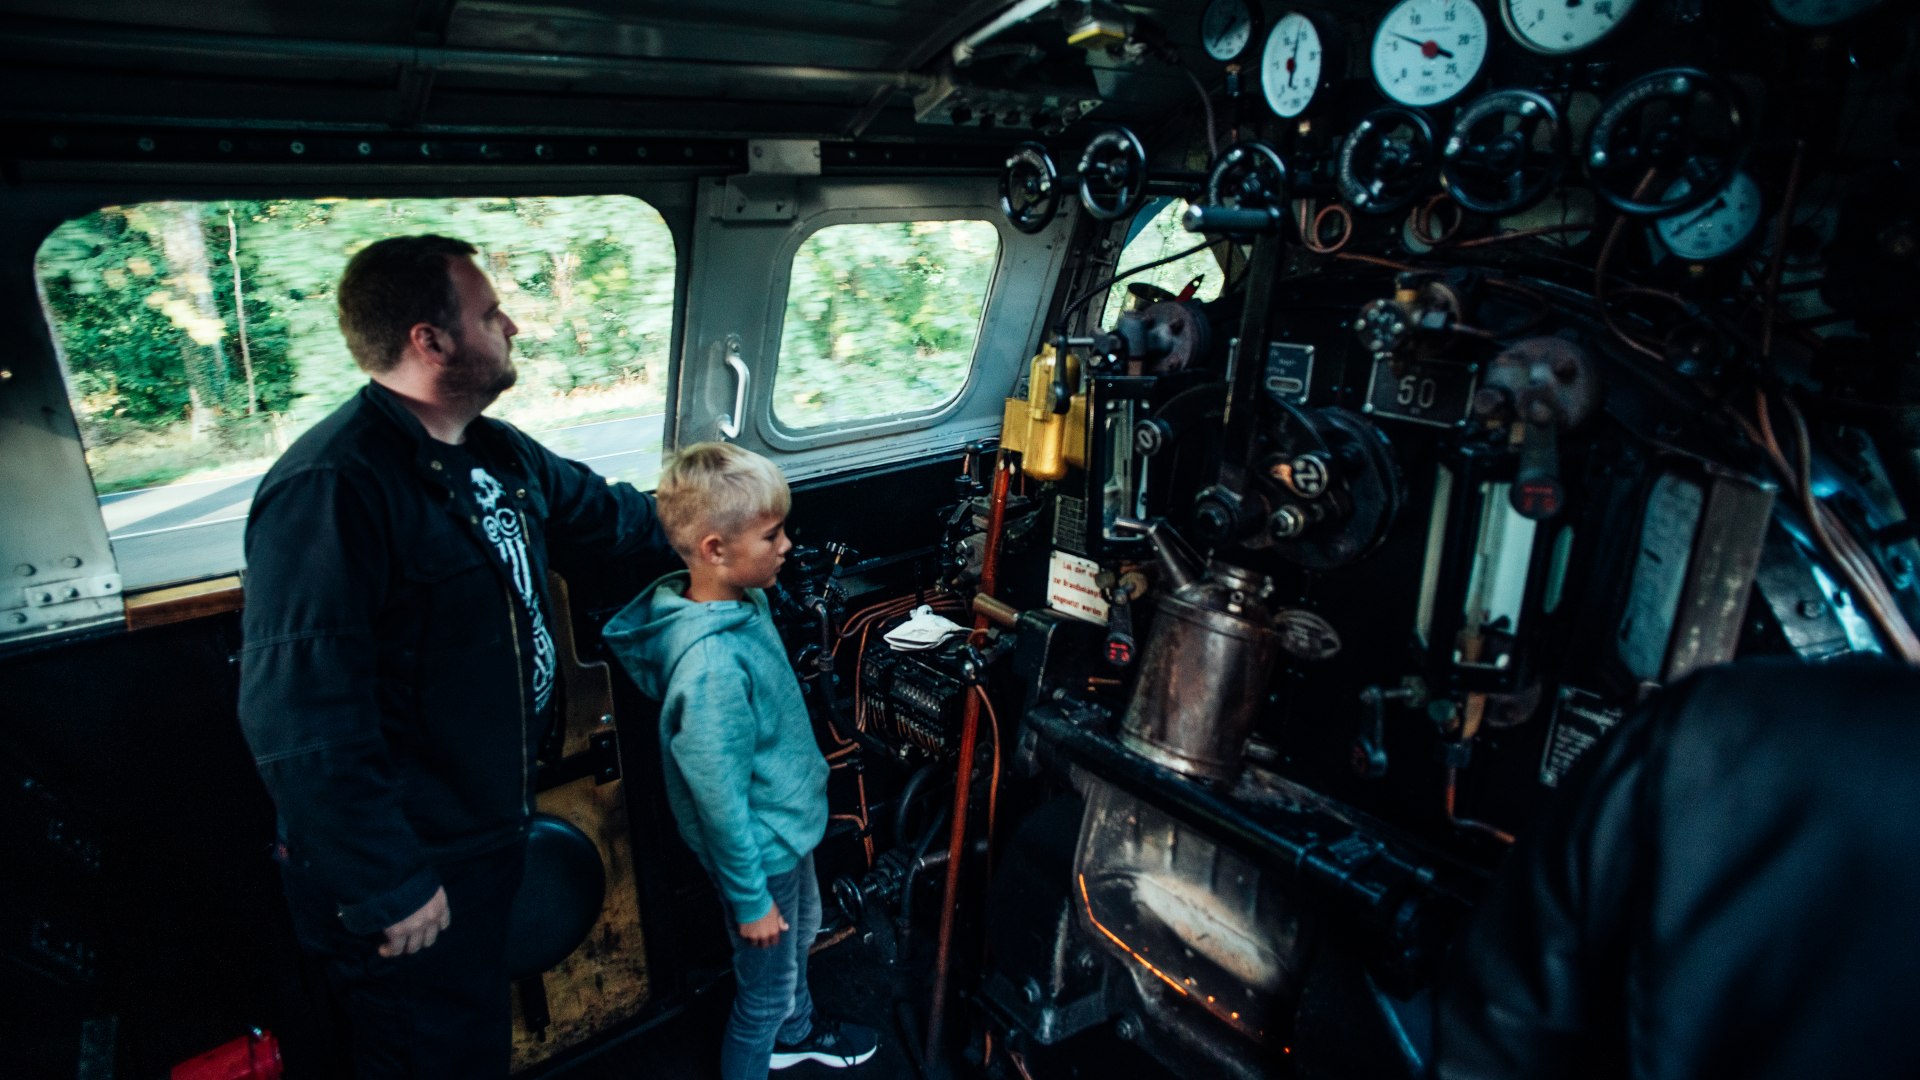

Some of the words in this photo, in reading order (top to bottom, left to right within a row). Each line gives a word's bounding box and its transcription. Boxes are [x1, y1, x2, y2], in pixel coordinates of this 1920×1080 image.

[1409, 14, 1421, 25] 10
[1444, 10, 1456, 22] 15
[1458, 34, 1470, 45] 20
[1392, 41, 1399, 51] 5
[1401, 68, 1407, 78] 0
[1445, 64, 1457, 75] 25
[1396, 374, 1437, 409] 50
[1082, 604, 1102, 616] werden
